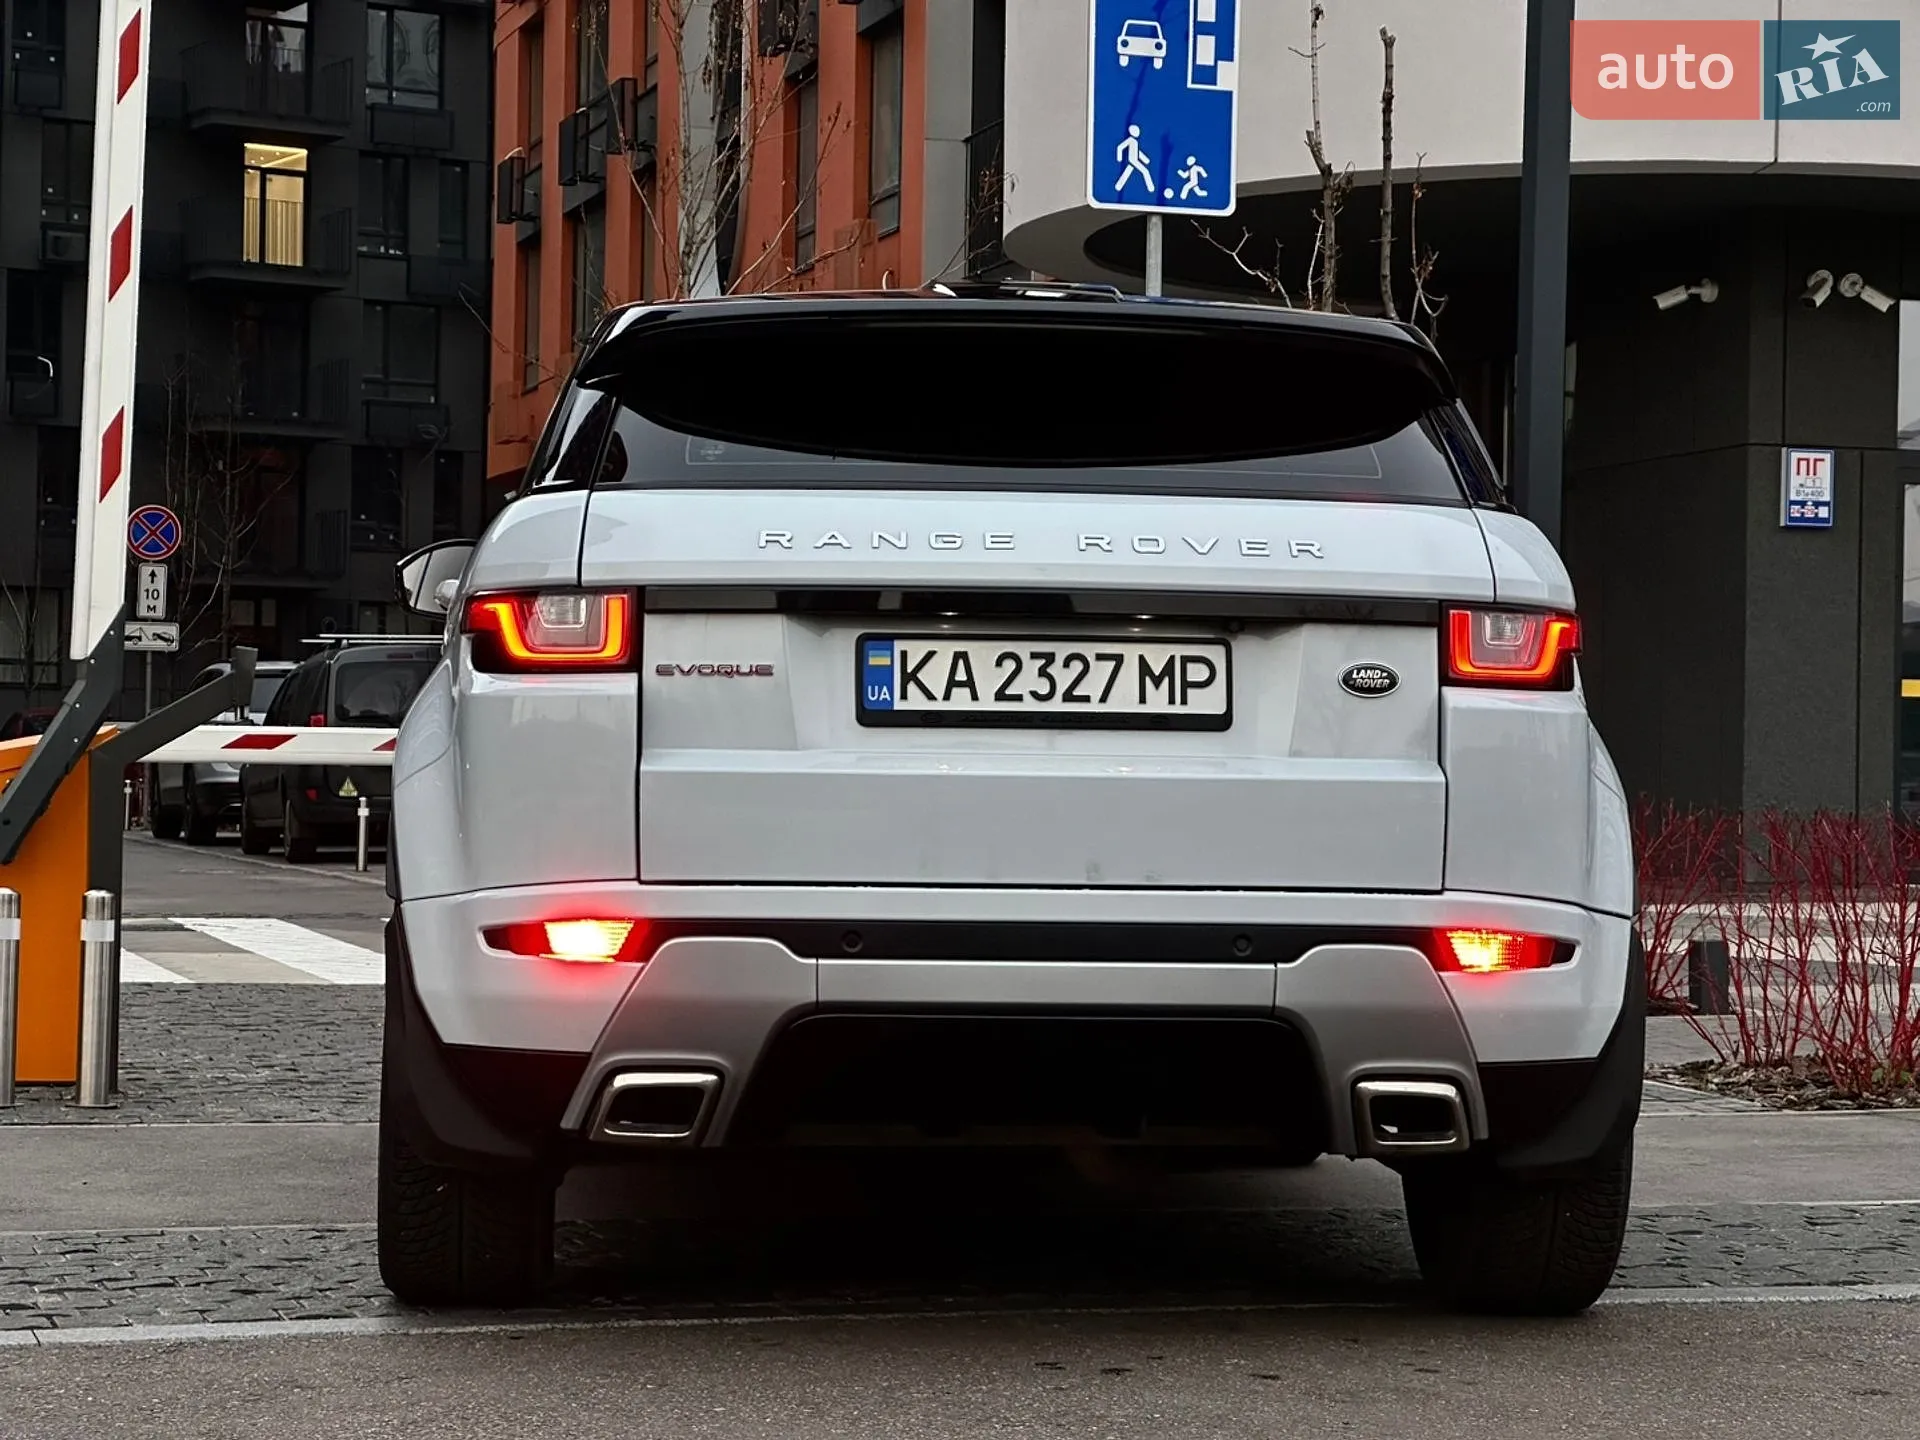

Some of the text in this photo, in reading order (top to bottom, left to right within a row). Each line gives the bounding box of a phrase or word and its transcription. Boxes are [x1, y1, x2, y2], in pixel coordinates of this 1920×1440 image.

[1796, 457, 1825, 476] ПГ
[757, 529, 1325, 560] RANGE ROVER
[143, 588, 160, 601] 10
[655, 664, 774, 678] EVOQUE
[899, 649, 1217, 706] KA 2327 MP
[868, 685, 891, 701] UA
